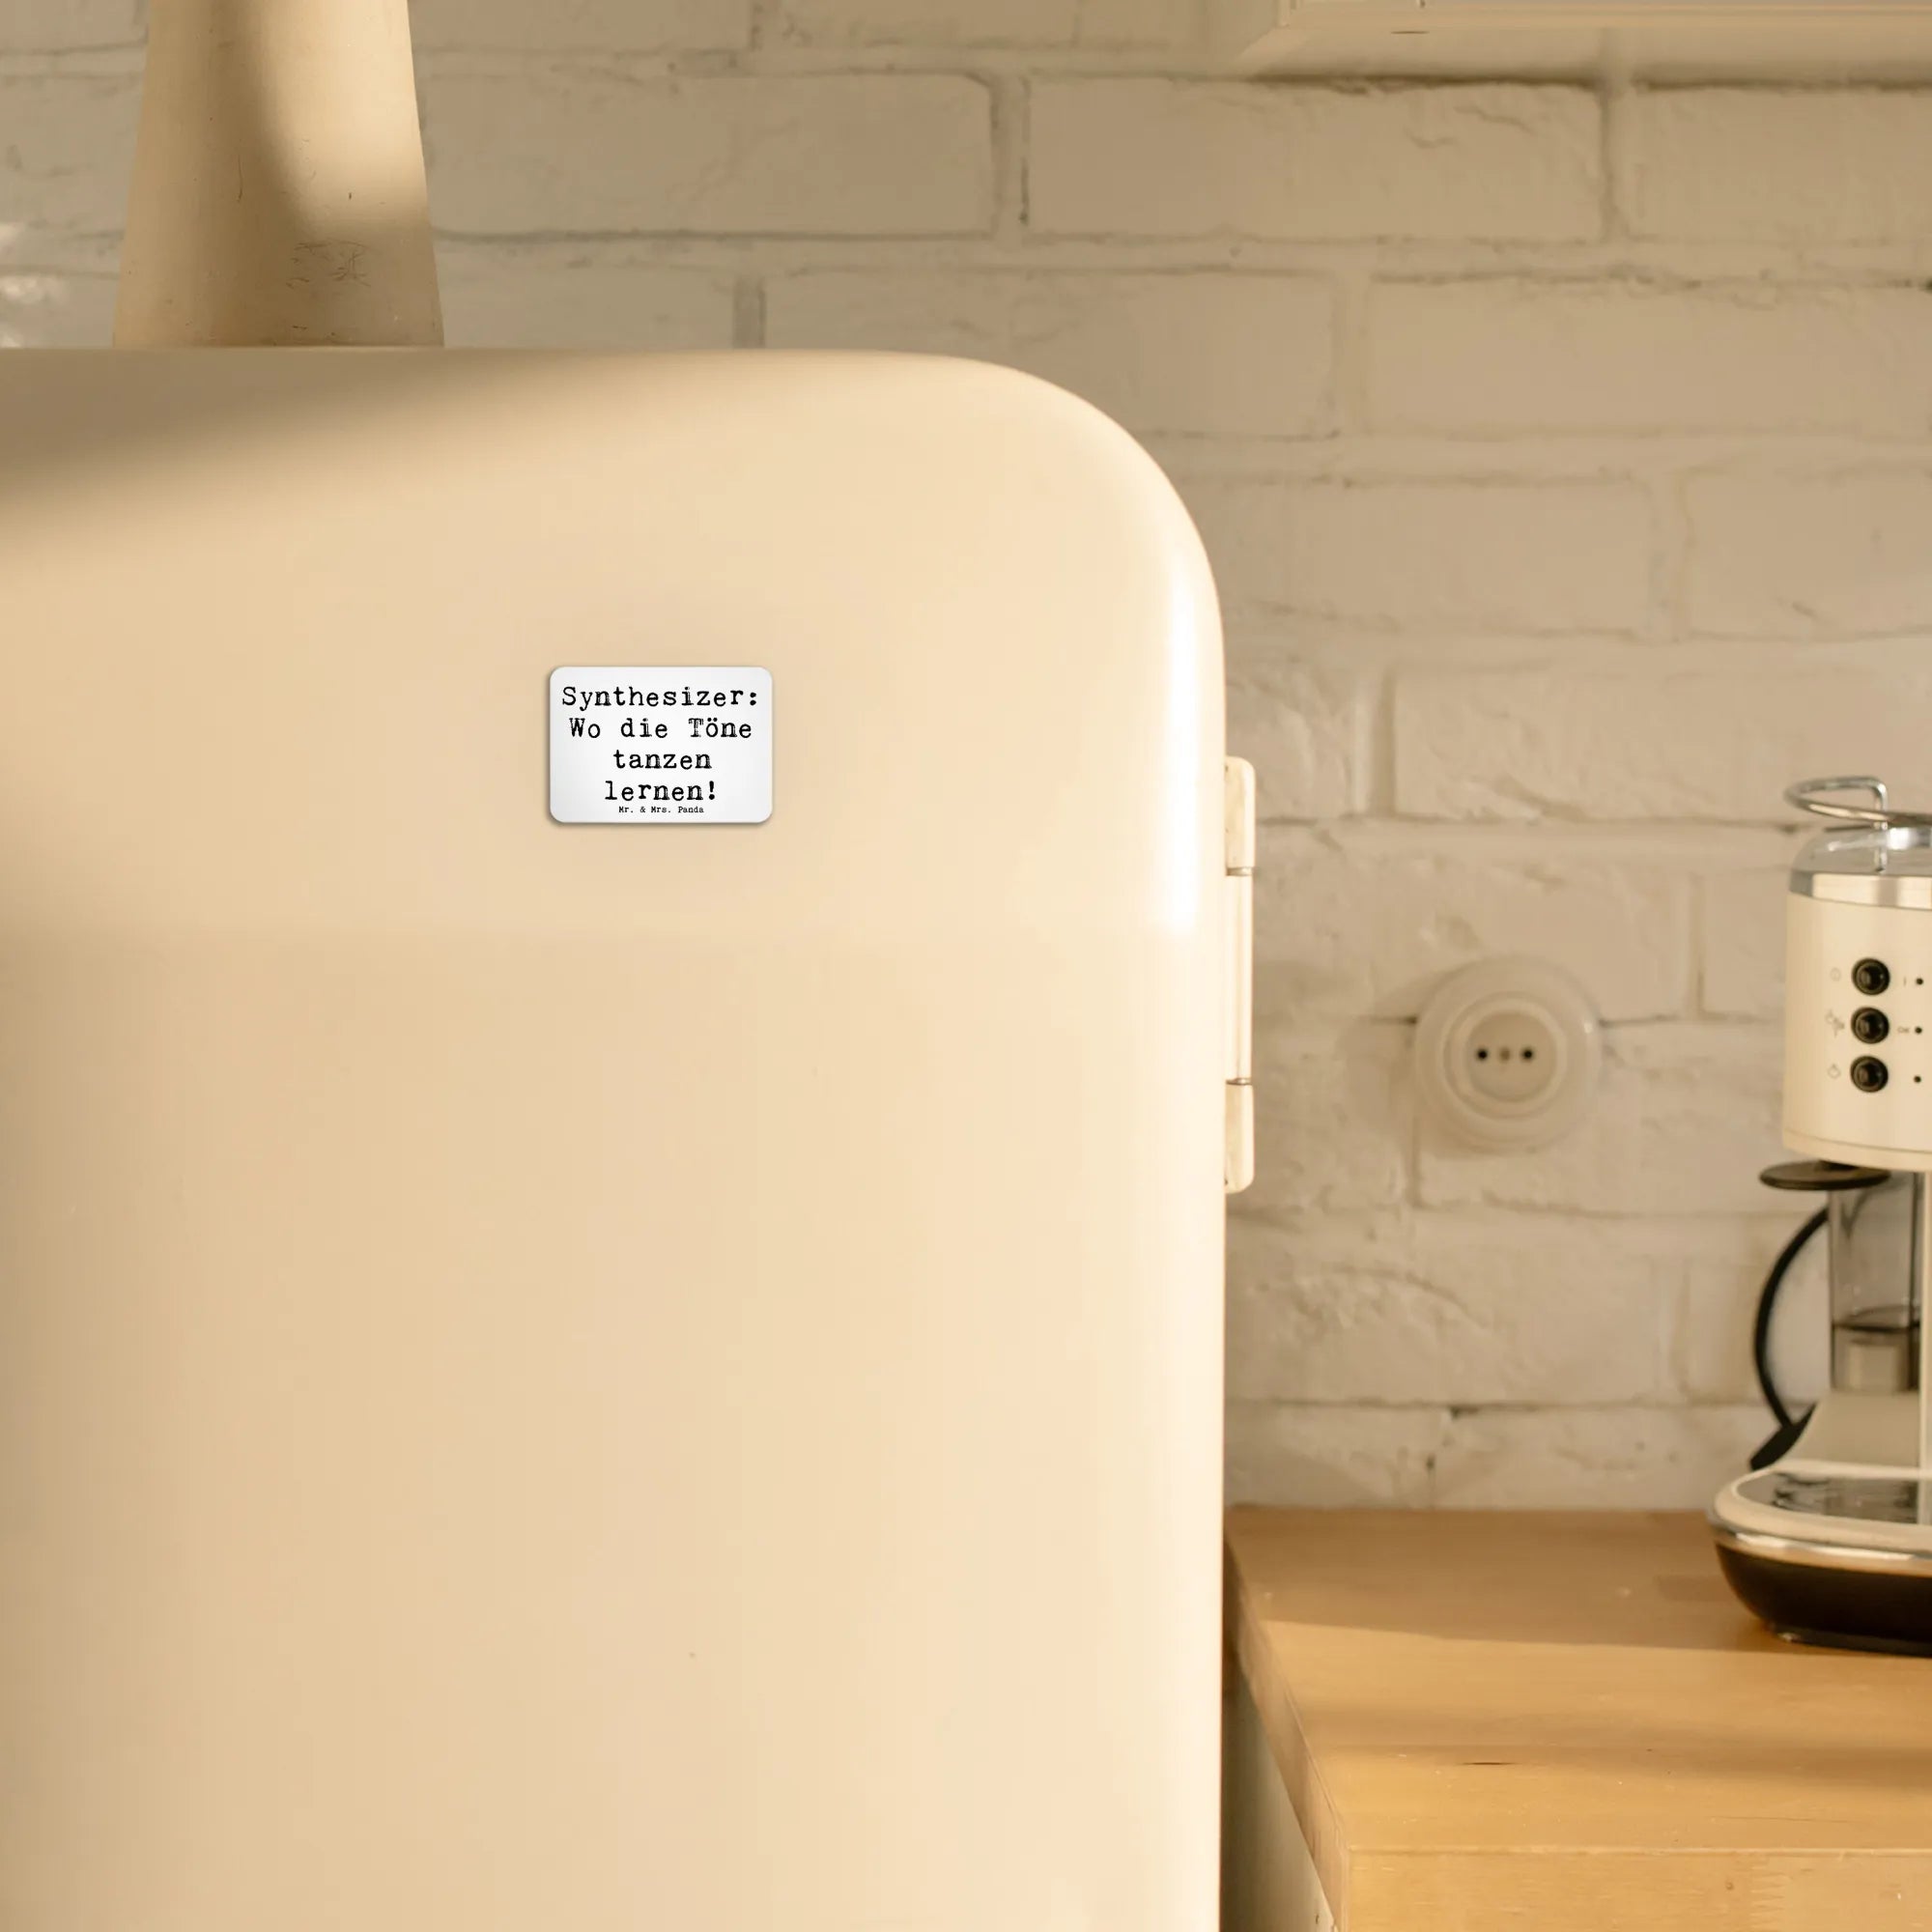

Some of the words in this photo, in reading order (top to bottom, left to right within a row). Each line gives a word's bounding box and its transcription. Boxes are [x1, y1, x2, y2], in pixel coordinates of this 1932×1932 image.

[561, 686, 757, 712] Synthesizer:
[568, 717, 601, 739] Wo
[620, 717, 668, 739] die
[688, 717, 752, 739] Töne
[612, 749, 713, 771] tanzen
[604, 780, 716, 802] lernen!
